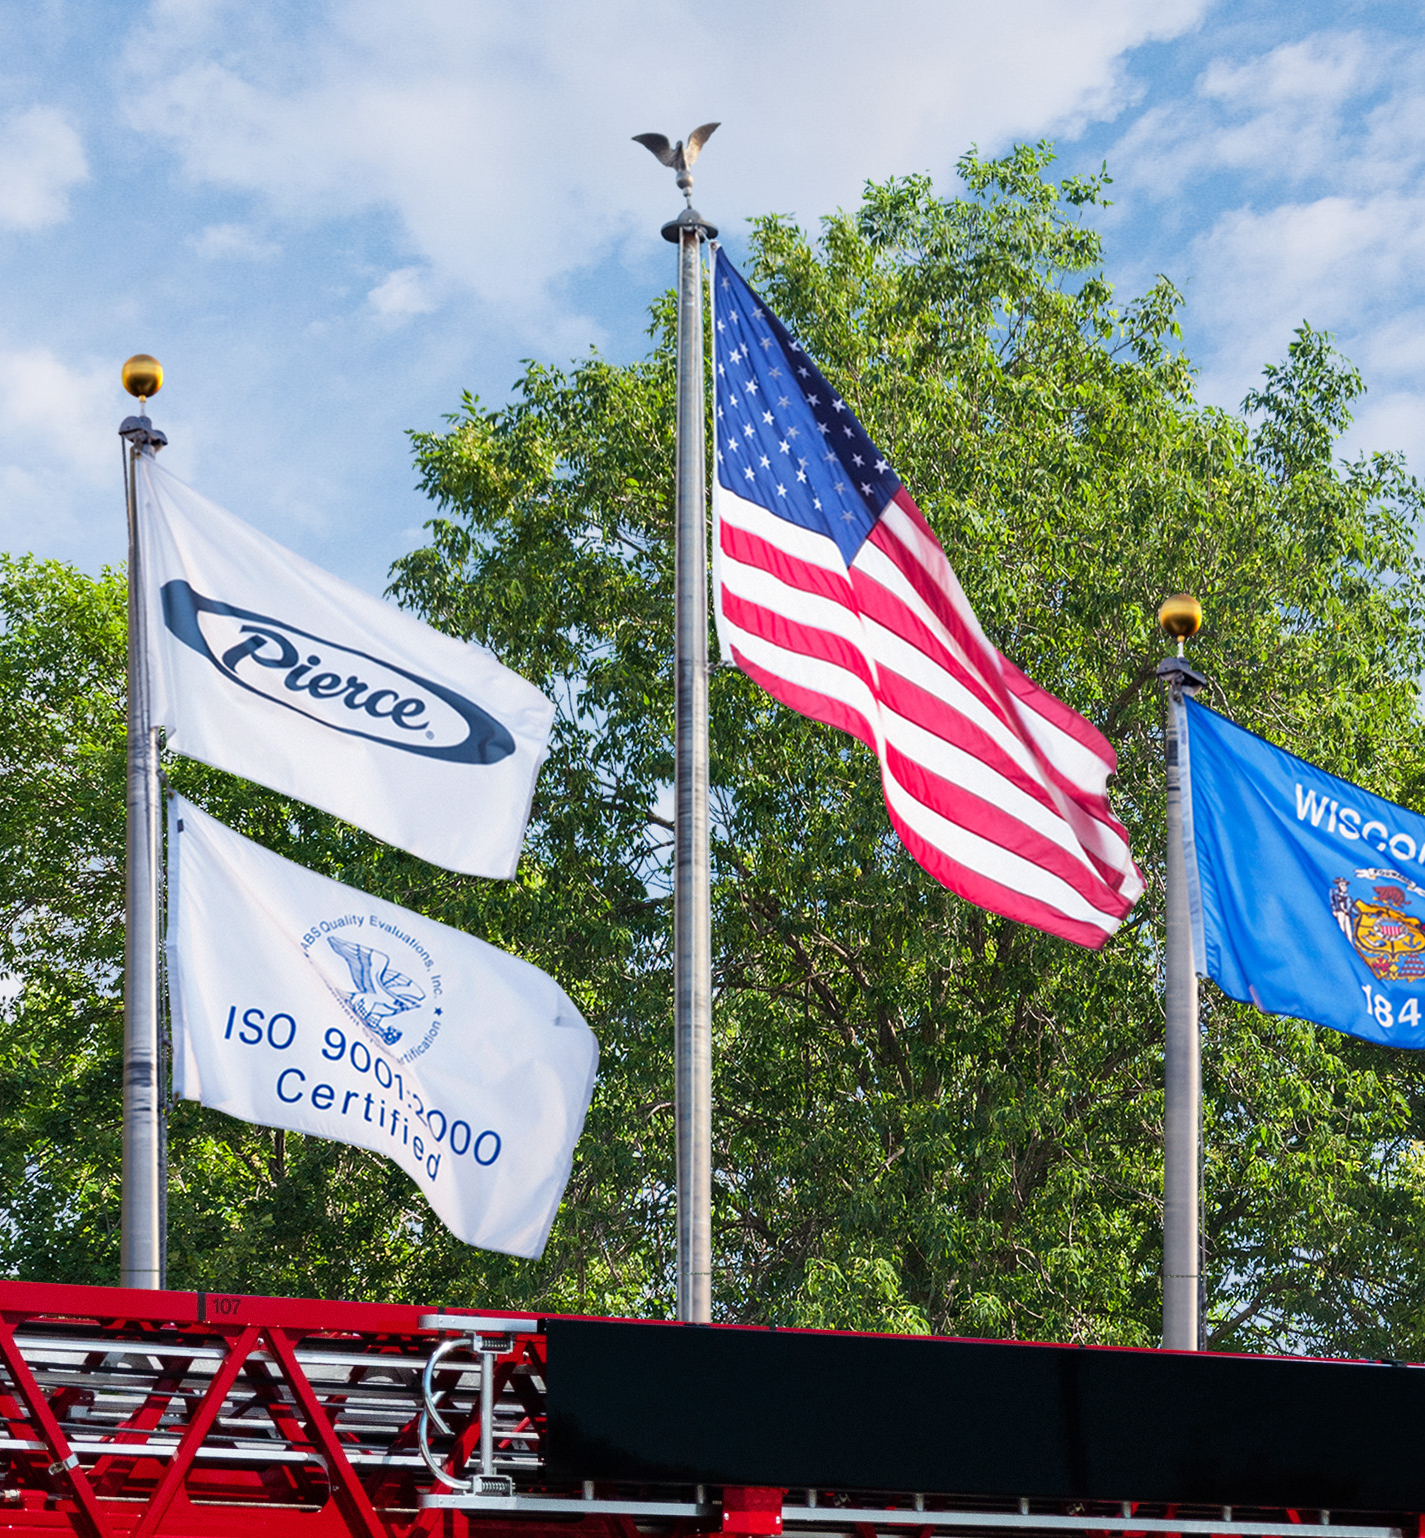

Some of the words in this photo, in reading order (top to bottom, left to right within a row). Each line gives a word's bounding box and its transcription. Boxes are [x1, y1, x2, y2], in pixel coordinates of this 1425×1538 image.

[222, 624, 430, 735] Pierce
[319, 914, 365, 933] Quality
[430, 974, 444, 999] Inc.
[224, 1005, 296, 1050] ISO
[276, 1067, 442, 1182] Certified
[213, 1299, 242, 1315] 107
